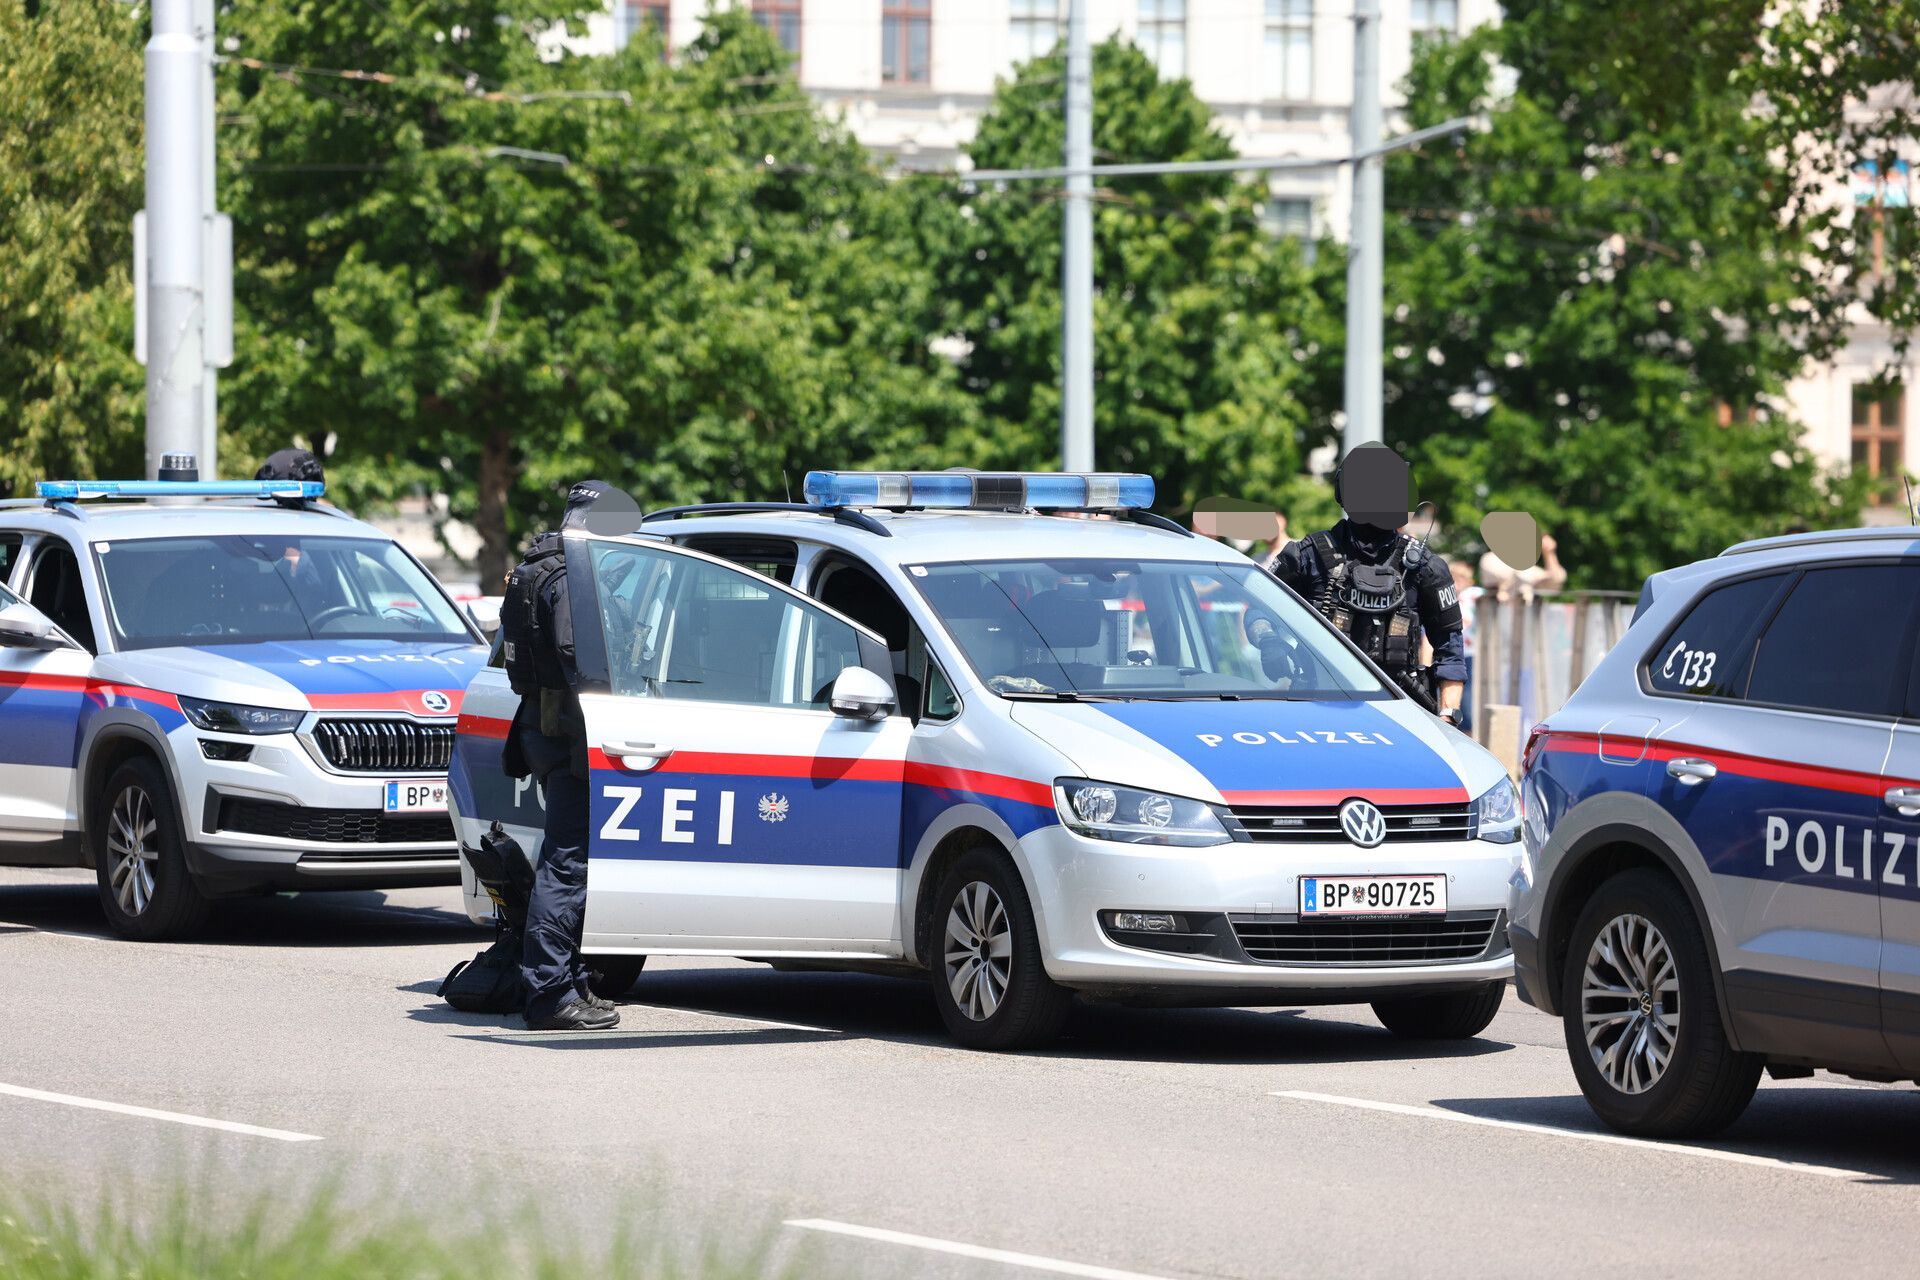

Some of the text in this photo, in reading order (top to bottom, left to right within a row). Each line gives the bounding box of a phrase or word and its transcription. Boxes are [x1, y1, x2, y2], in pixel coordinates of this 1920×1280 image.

[1350, 588, 1390, 609] POLIZEI
[299, 654, 465, 667] POLIZEI
[1678, 650, 1717, 688] 133
[1195, 731, 1394, 747] POLIZEI
[407, 787, 430, 806] BP
[1765, 815, 1920, 888] POLIZ
[1324, 883, 1350, 908] BP
[1368, 882, 1435, 907] 90725
